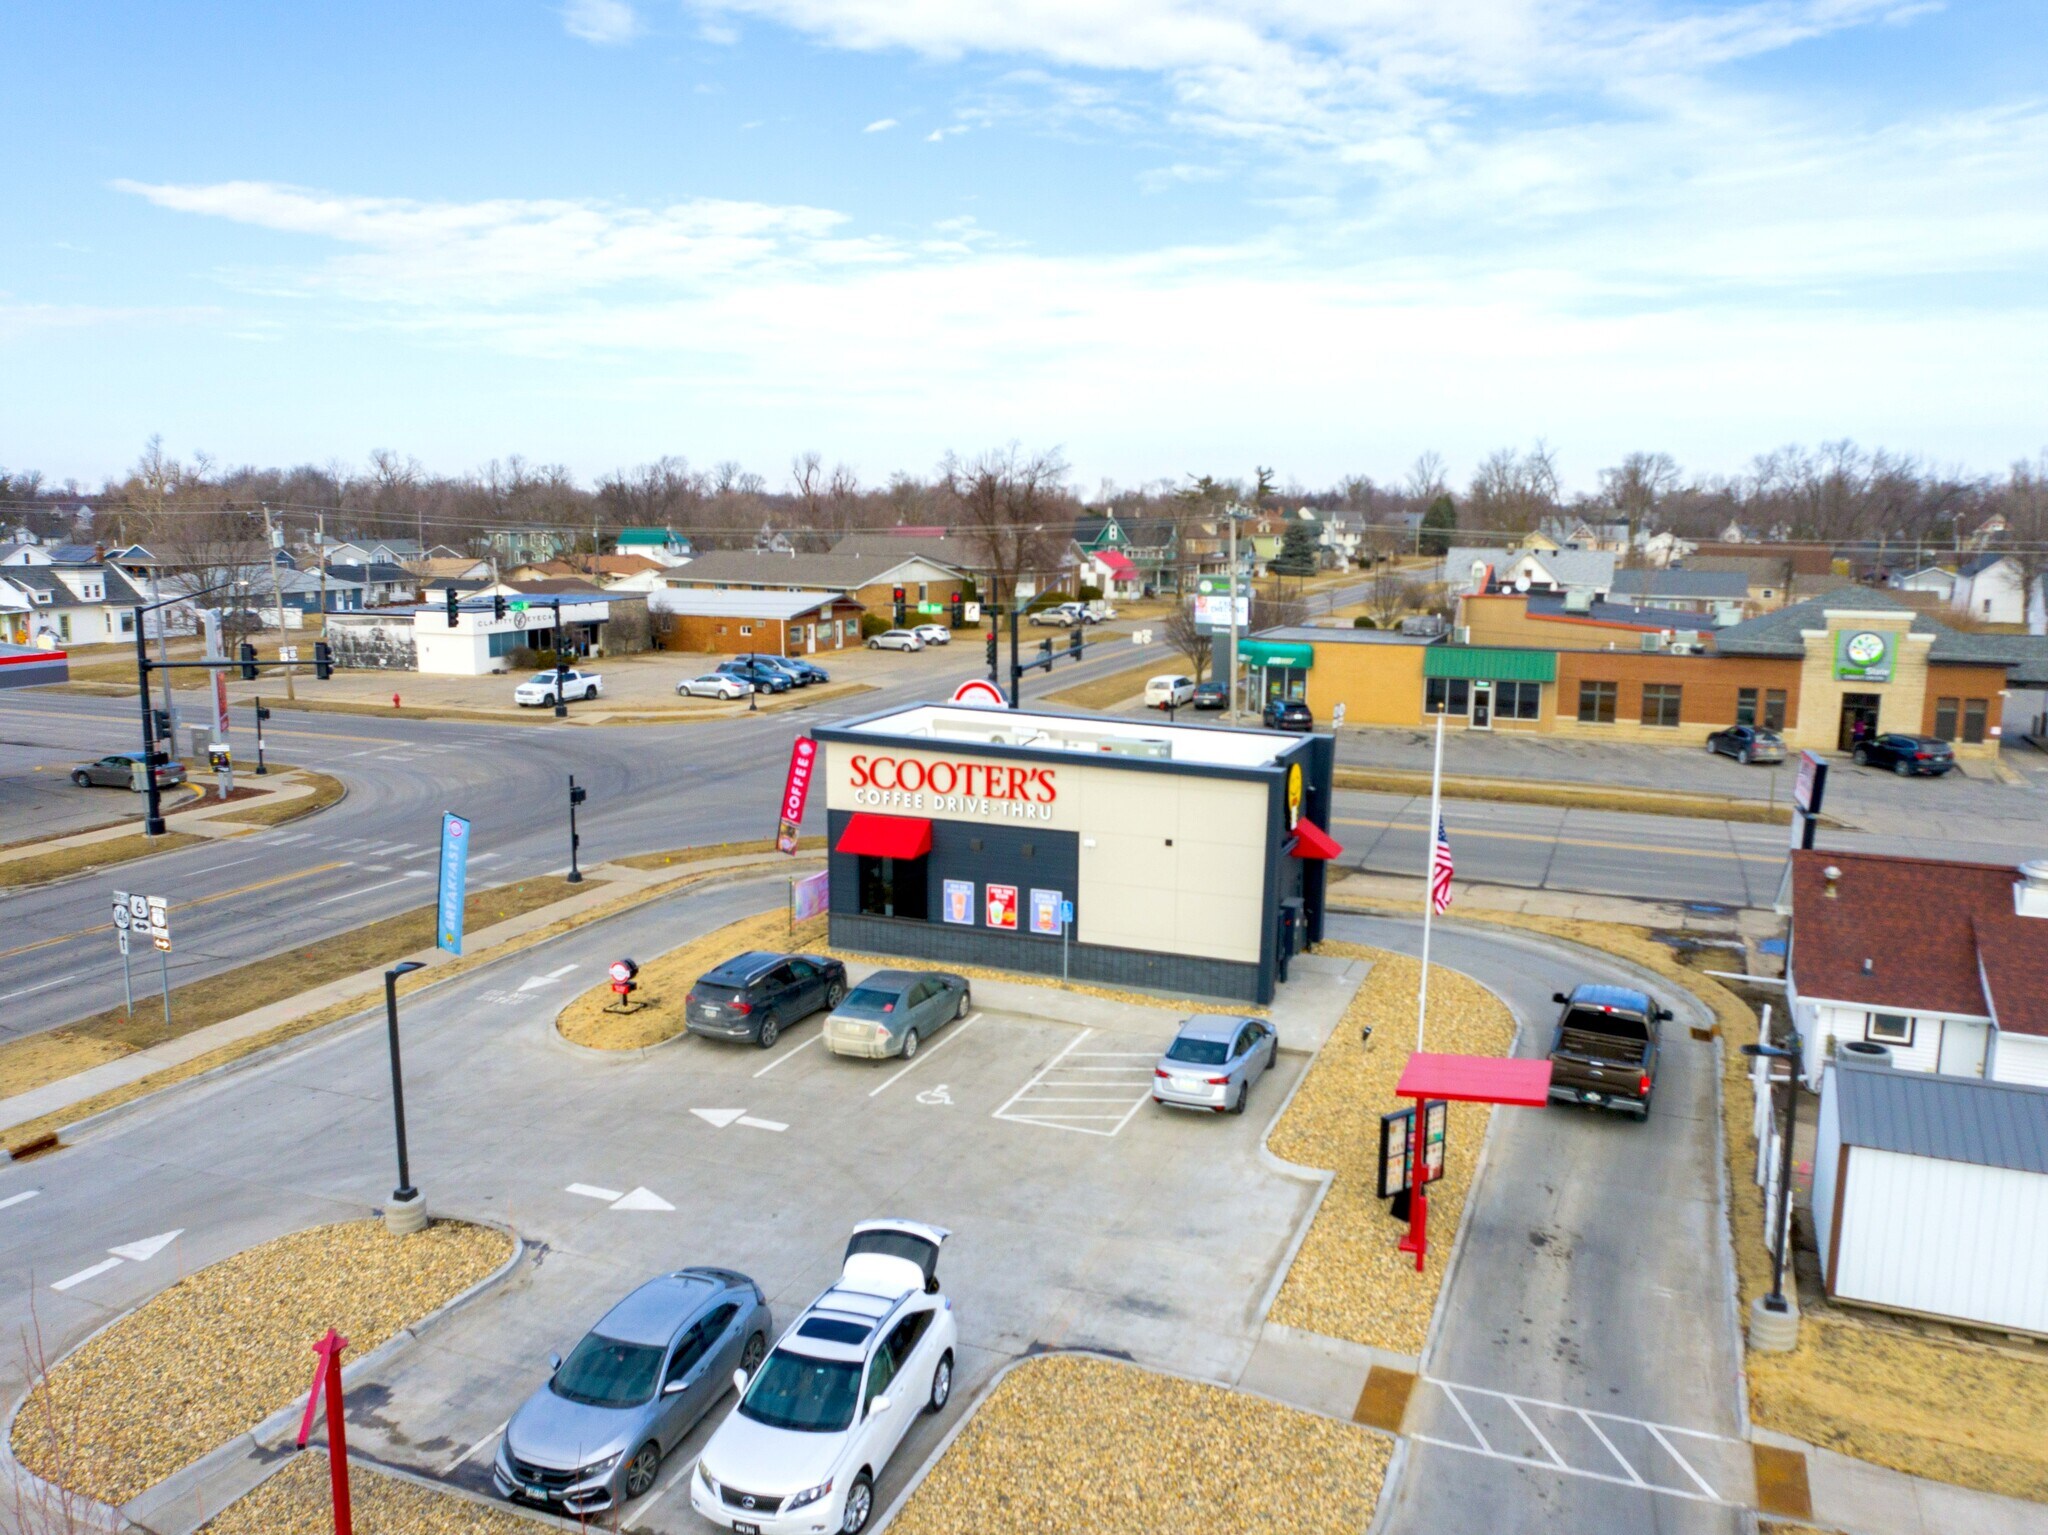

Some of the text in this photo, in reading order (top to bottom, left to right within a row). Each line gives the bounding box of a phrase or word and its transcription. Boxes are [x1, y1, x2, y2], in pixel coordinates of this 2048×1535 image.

[786, 757, 809, 820] COFFEE
[850, 755, 1057, 803] SCOOTER'S
[854, 788, 924, 810] COFFEE
[136, 901, 143, 914] 6
[444, 840, 460, 932] BREAKFAST
